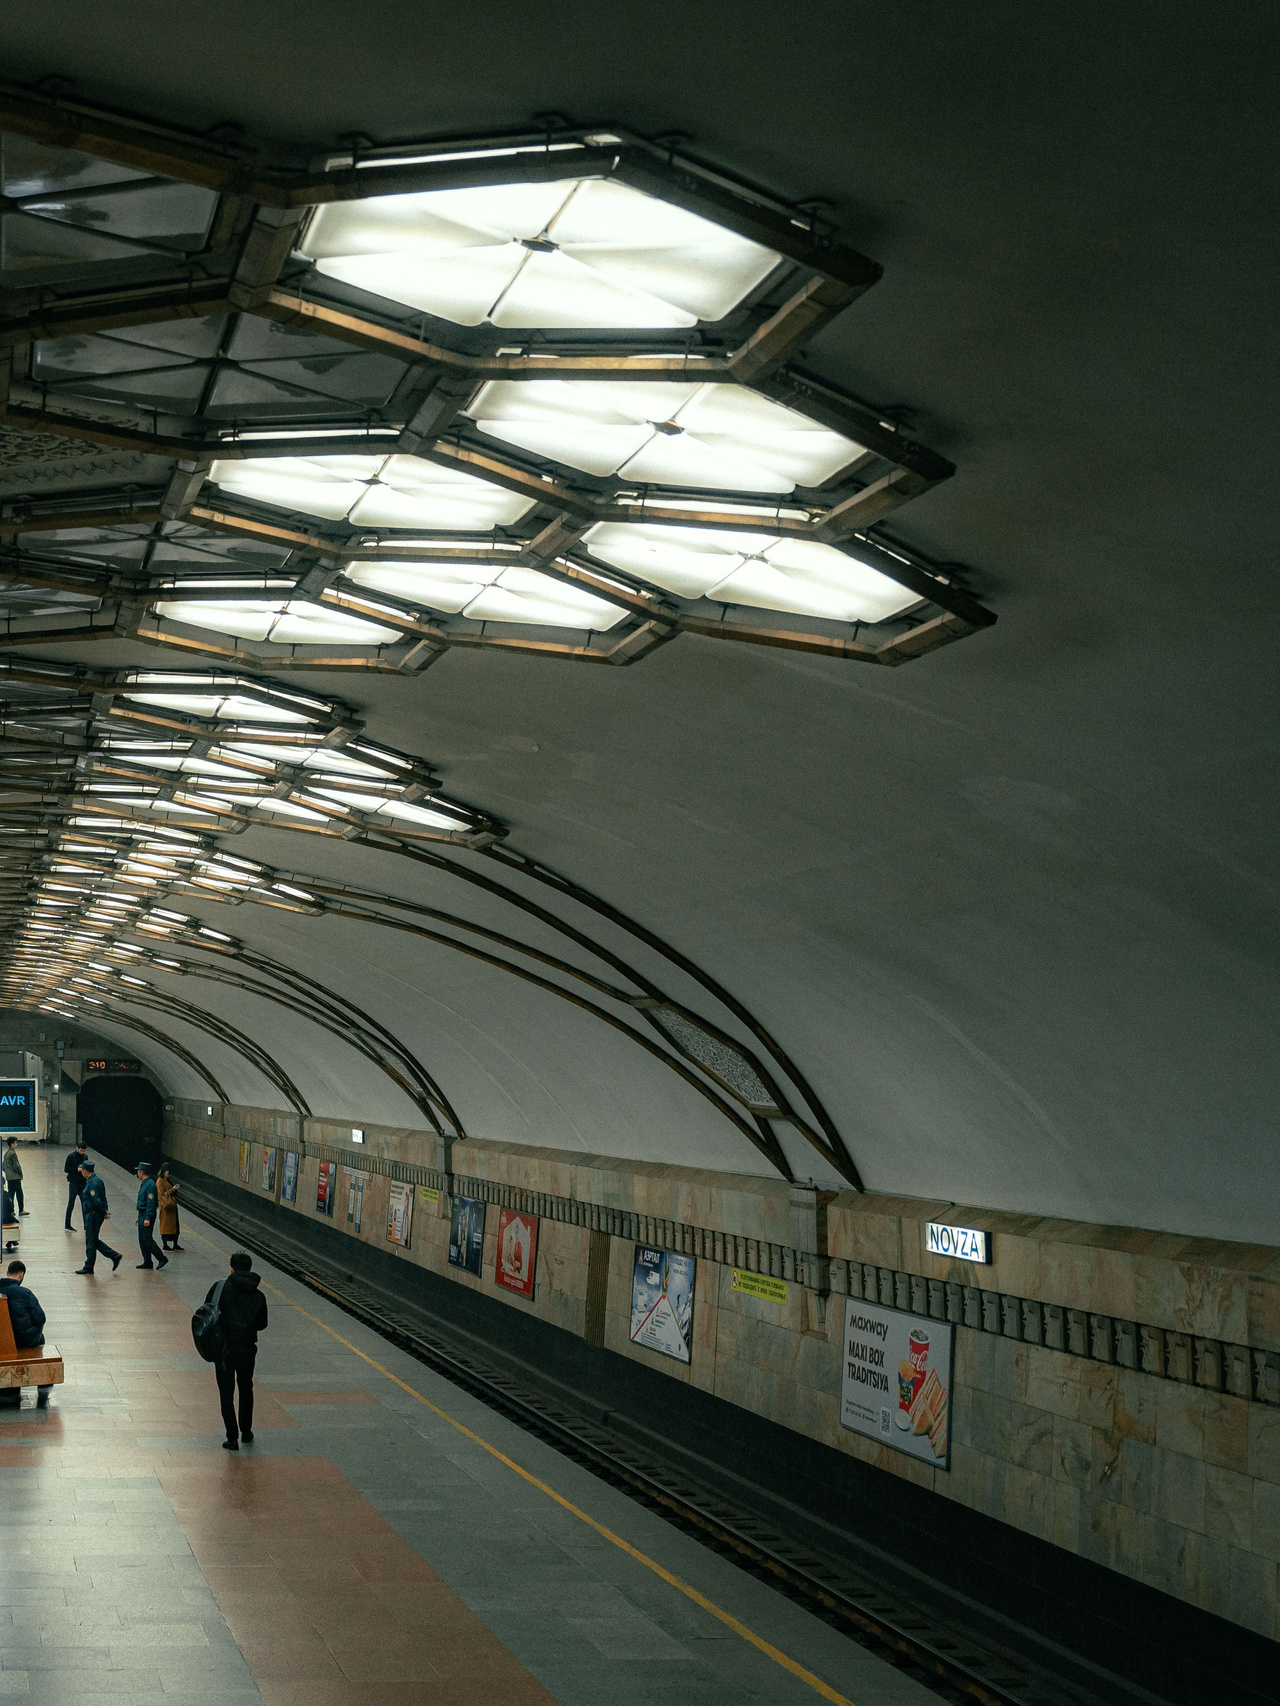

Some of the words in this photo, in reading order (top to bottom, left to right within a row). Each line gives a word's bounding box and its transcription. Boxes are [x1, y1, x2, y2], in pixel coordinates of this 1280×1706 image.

[930, 1225, 979, 1259] NOVZA
[849, 1340, 868, 1362] MAXI
[869, 1346, 885, 1368] BOX
[848, 1361, 889, 1393] TRADITSIYA
